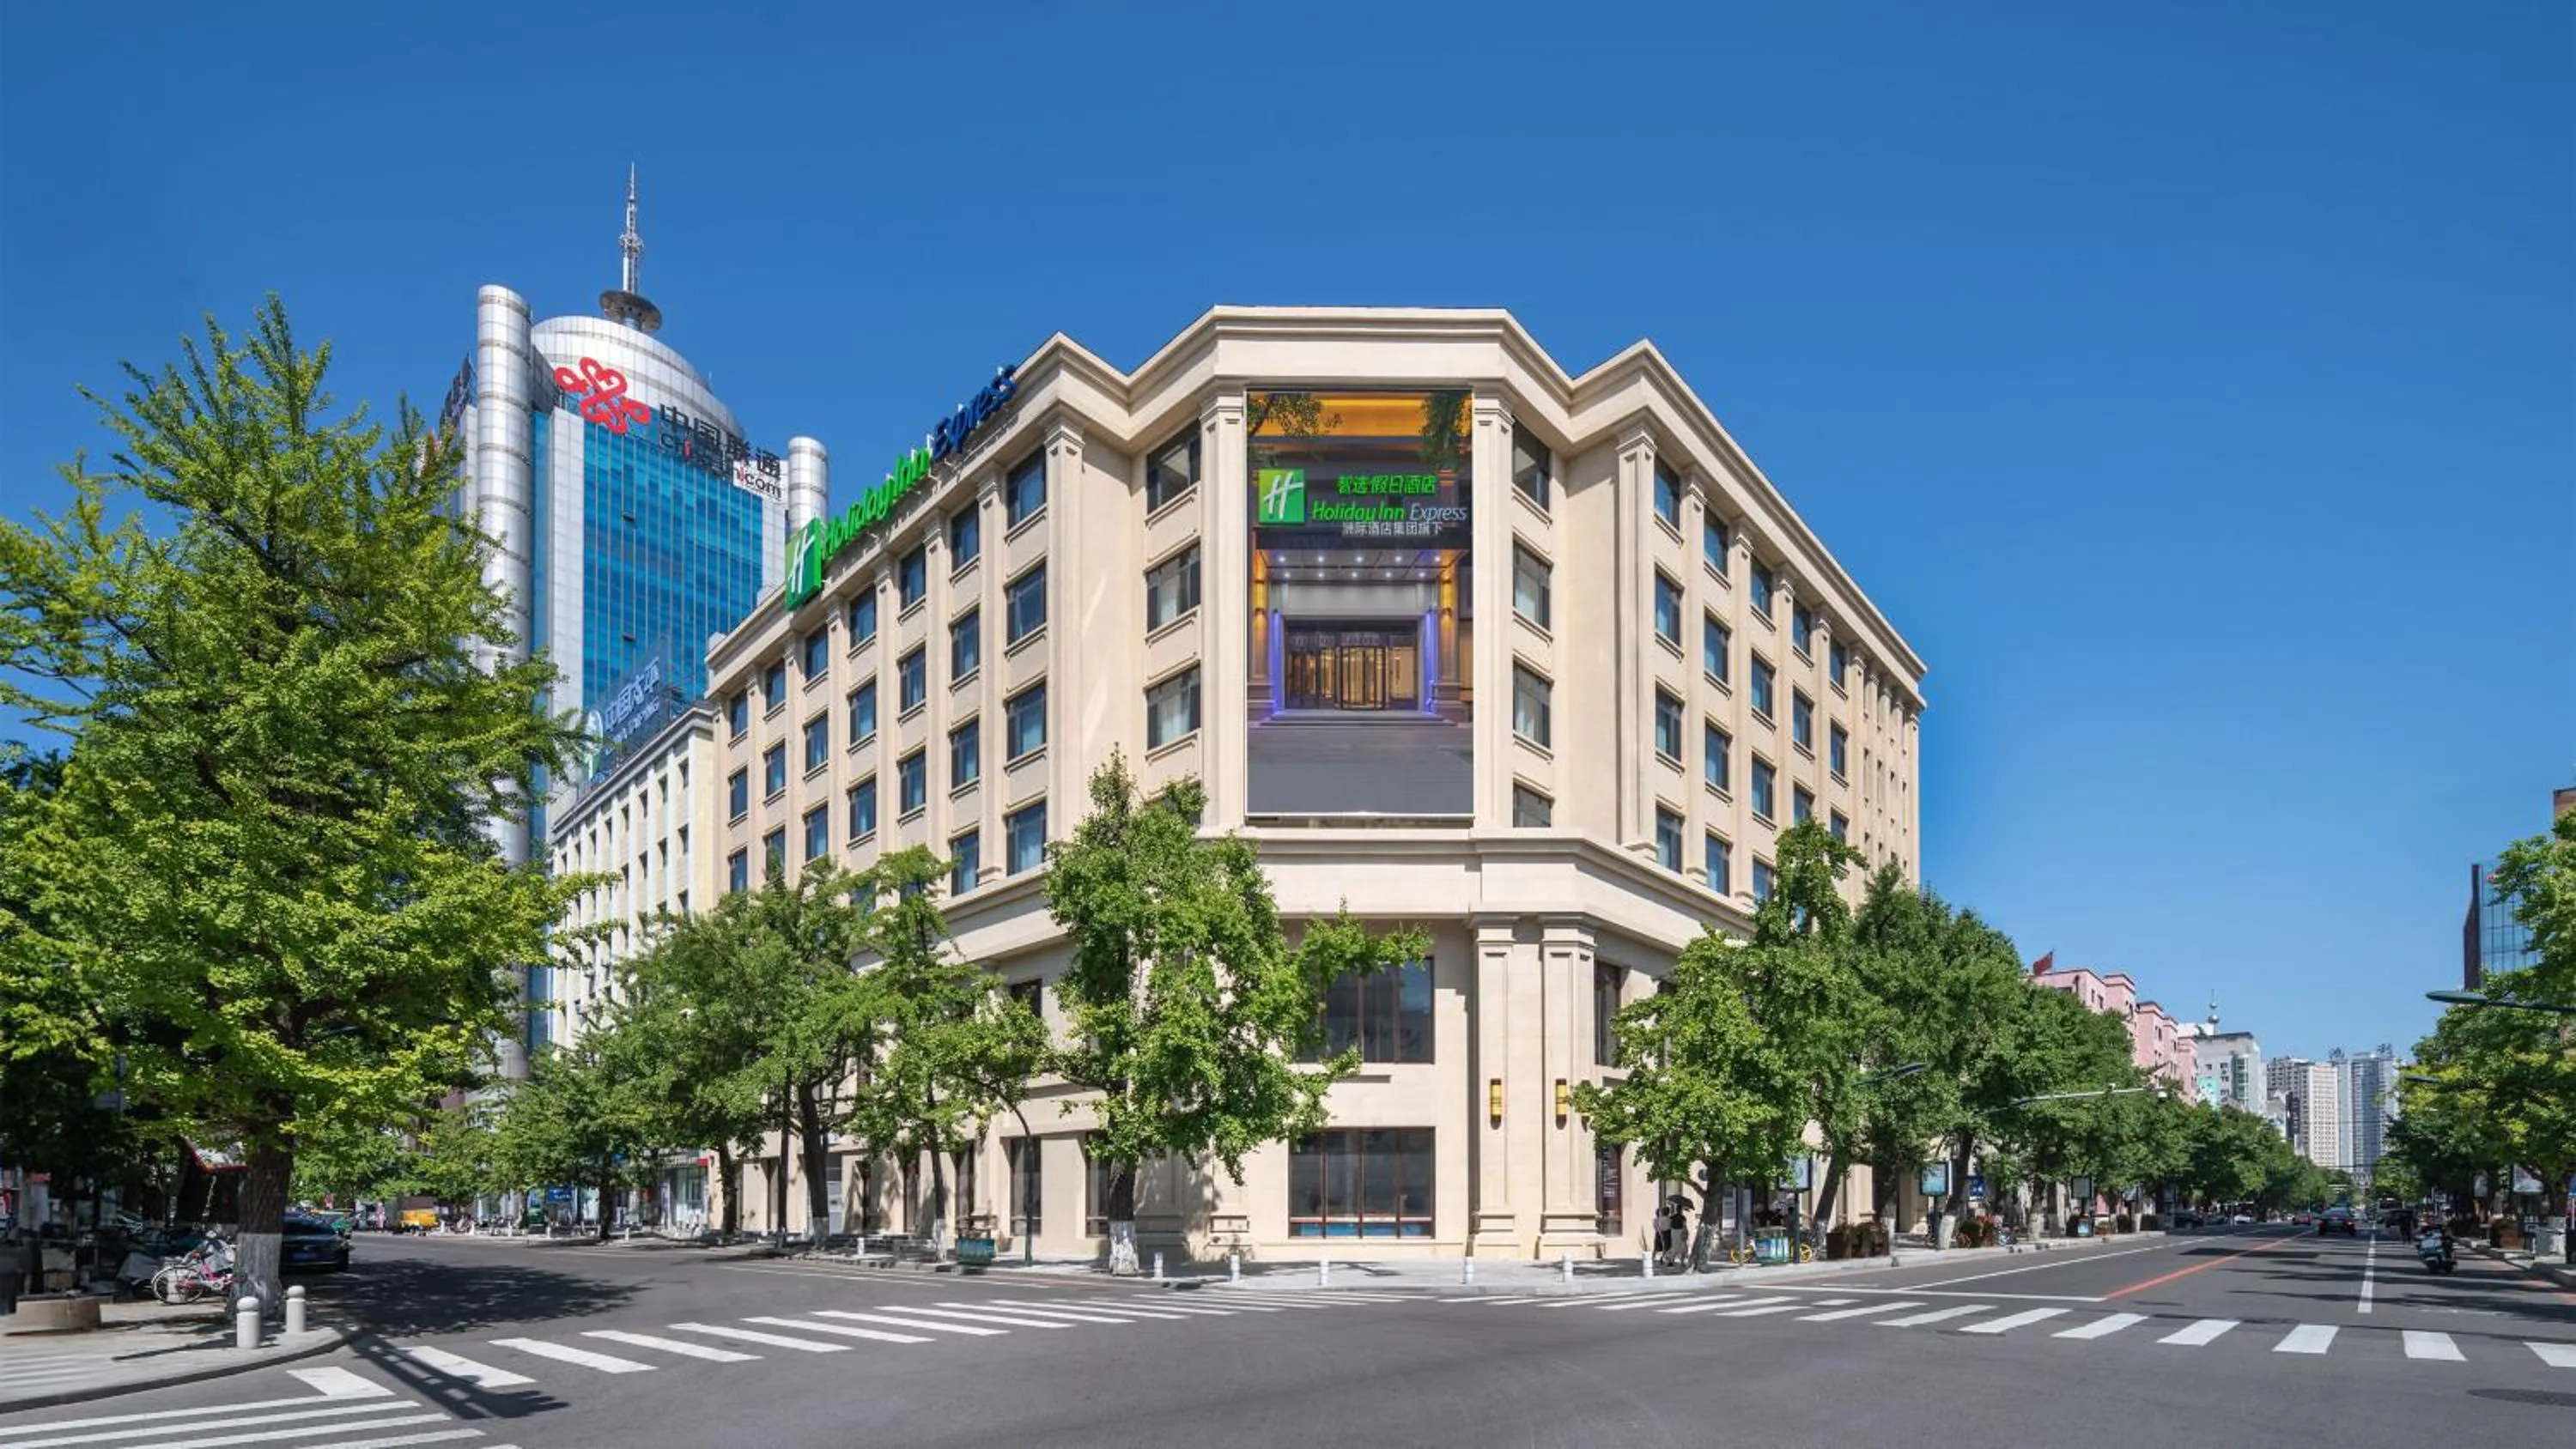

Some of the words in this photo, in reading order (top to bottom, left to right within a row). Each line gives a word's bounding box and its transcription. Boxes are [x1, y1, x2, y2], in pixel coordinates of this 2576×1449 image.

[659, 402, 781, 482] 中国联通
[1339, 474, 1437, 494] 智选假日酒店
[823, 477, 893, 561] Holiday
[895, 452, 930, 498] Inn
[1311, 500, 1375, 523] Holiday
[1378, 500, 1406, 522] Inn
[1409, 502, 1467, 523] Express
[1342, 520, 1443, 537] 洲际酒店集团旗下
